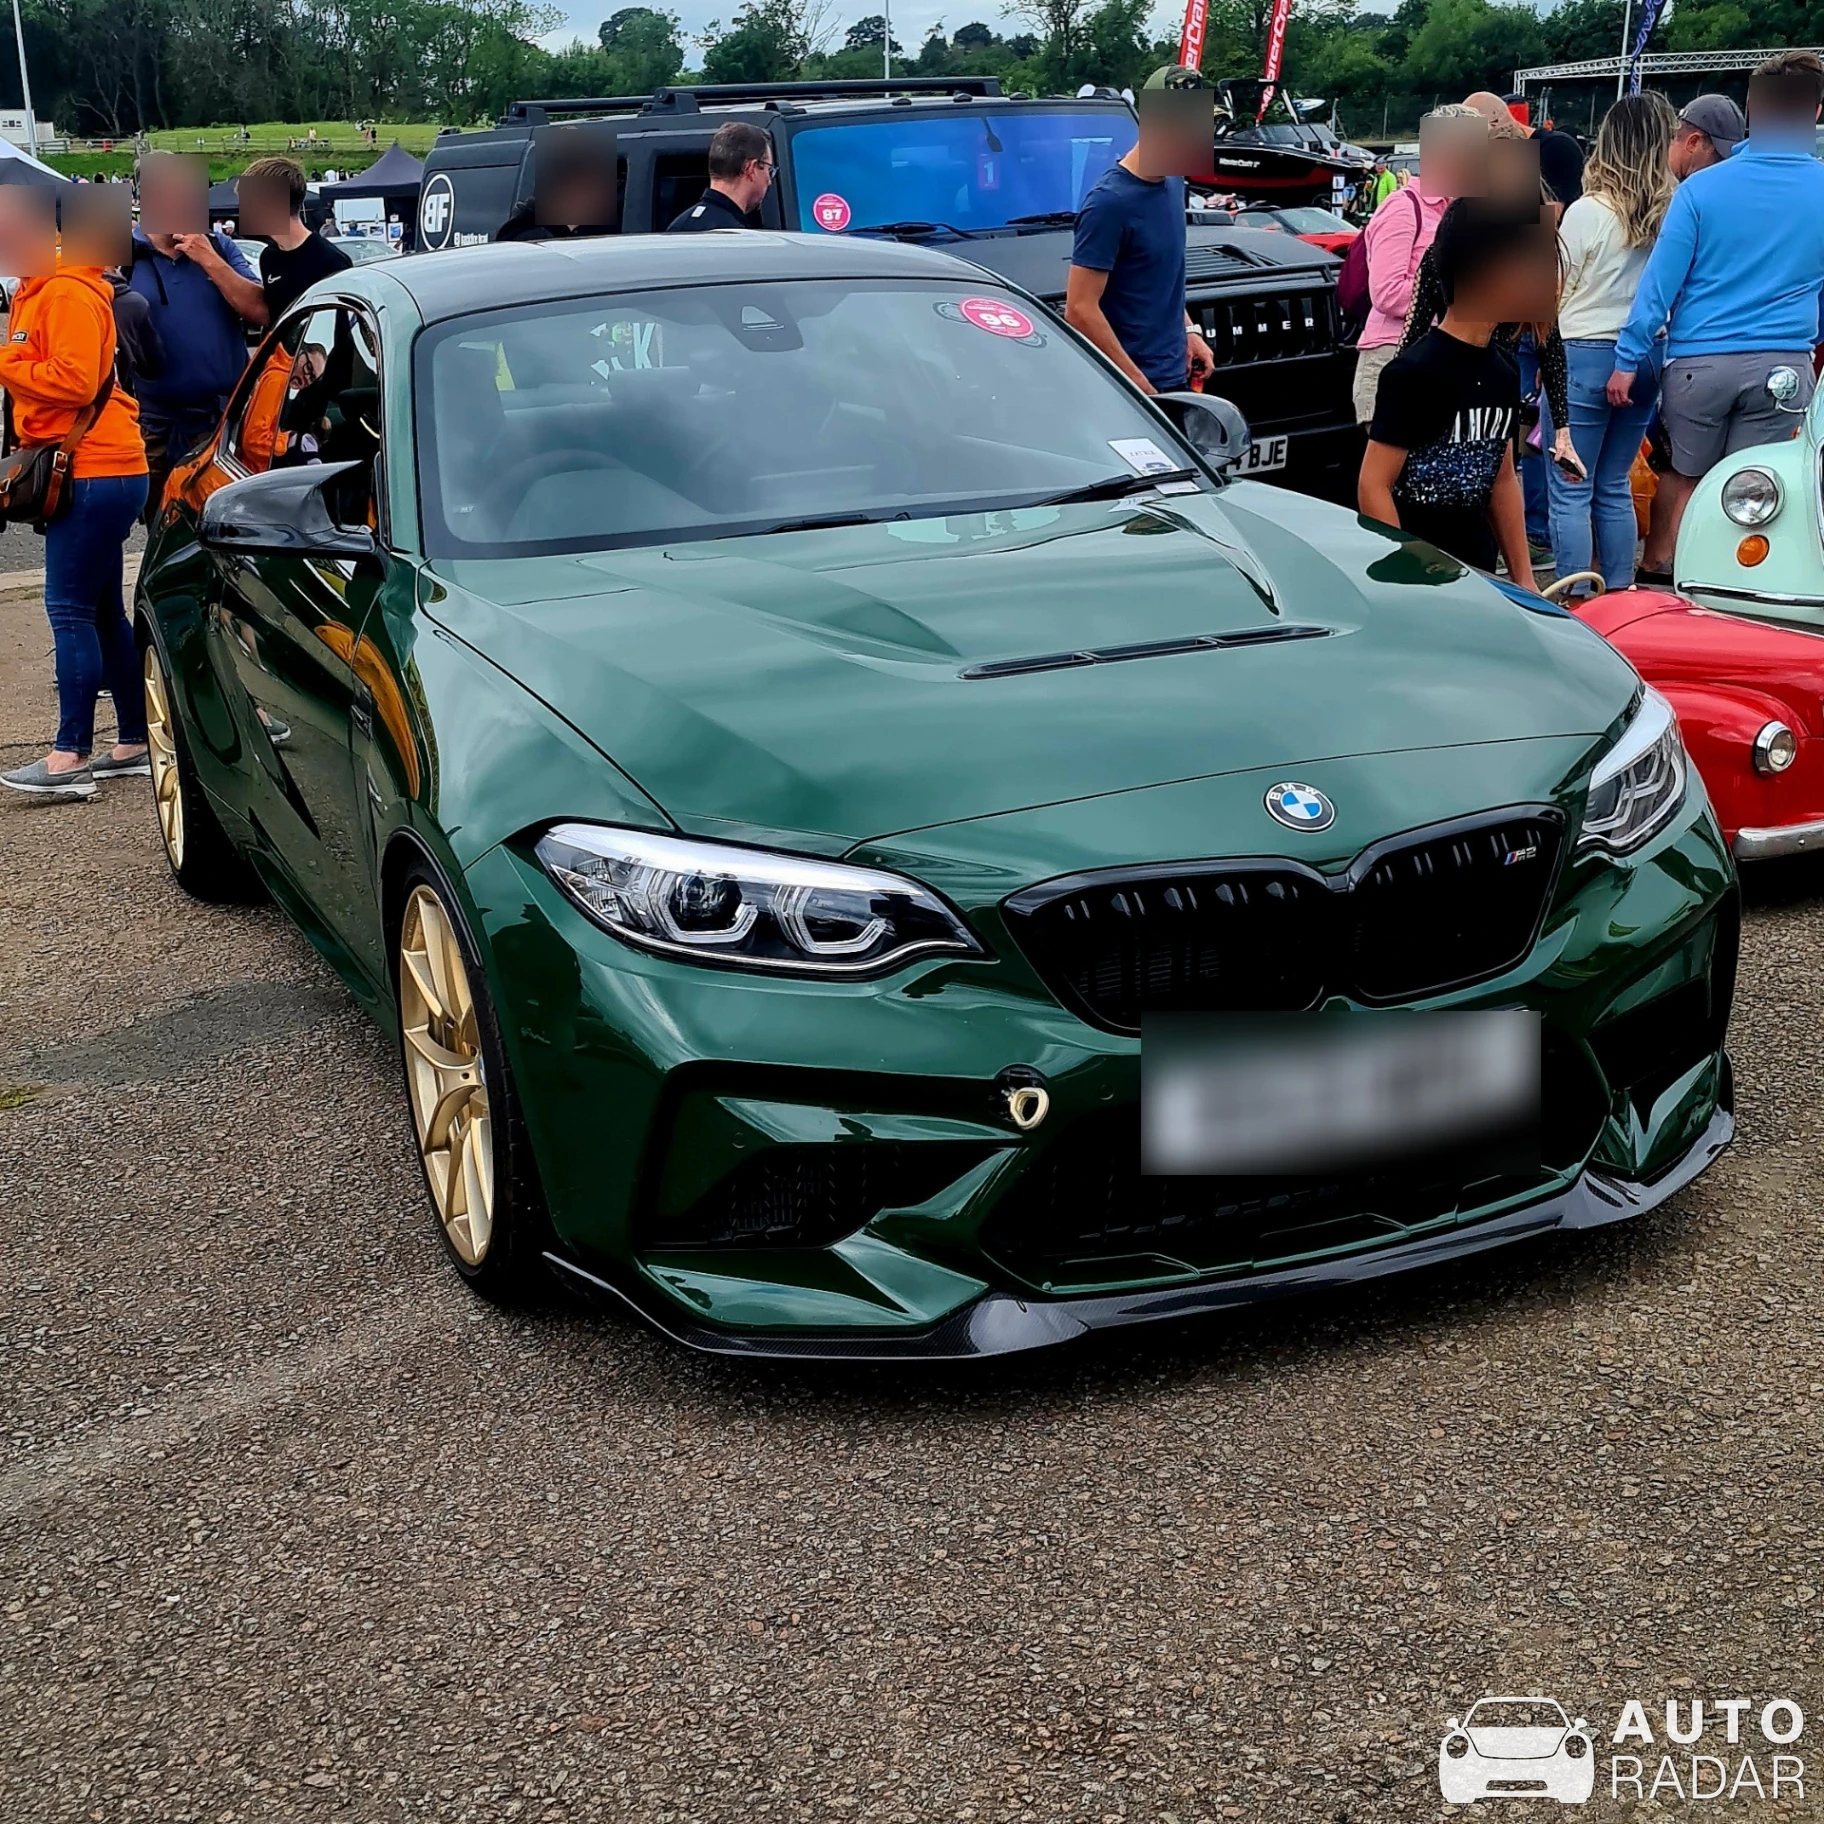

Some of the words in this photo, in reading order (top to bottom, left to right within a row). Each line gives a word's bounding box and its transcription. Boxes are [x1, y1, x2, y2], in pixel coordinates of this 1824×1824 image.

[821, 208, 843, 221] 87
[977, 312, 1021, 328] 96
[1205, 317, 1314, 338] UMMER
[1248, 438, 1287, 469] BJE
[1269, 783, 1318, 801] BMW
